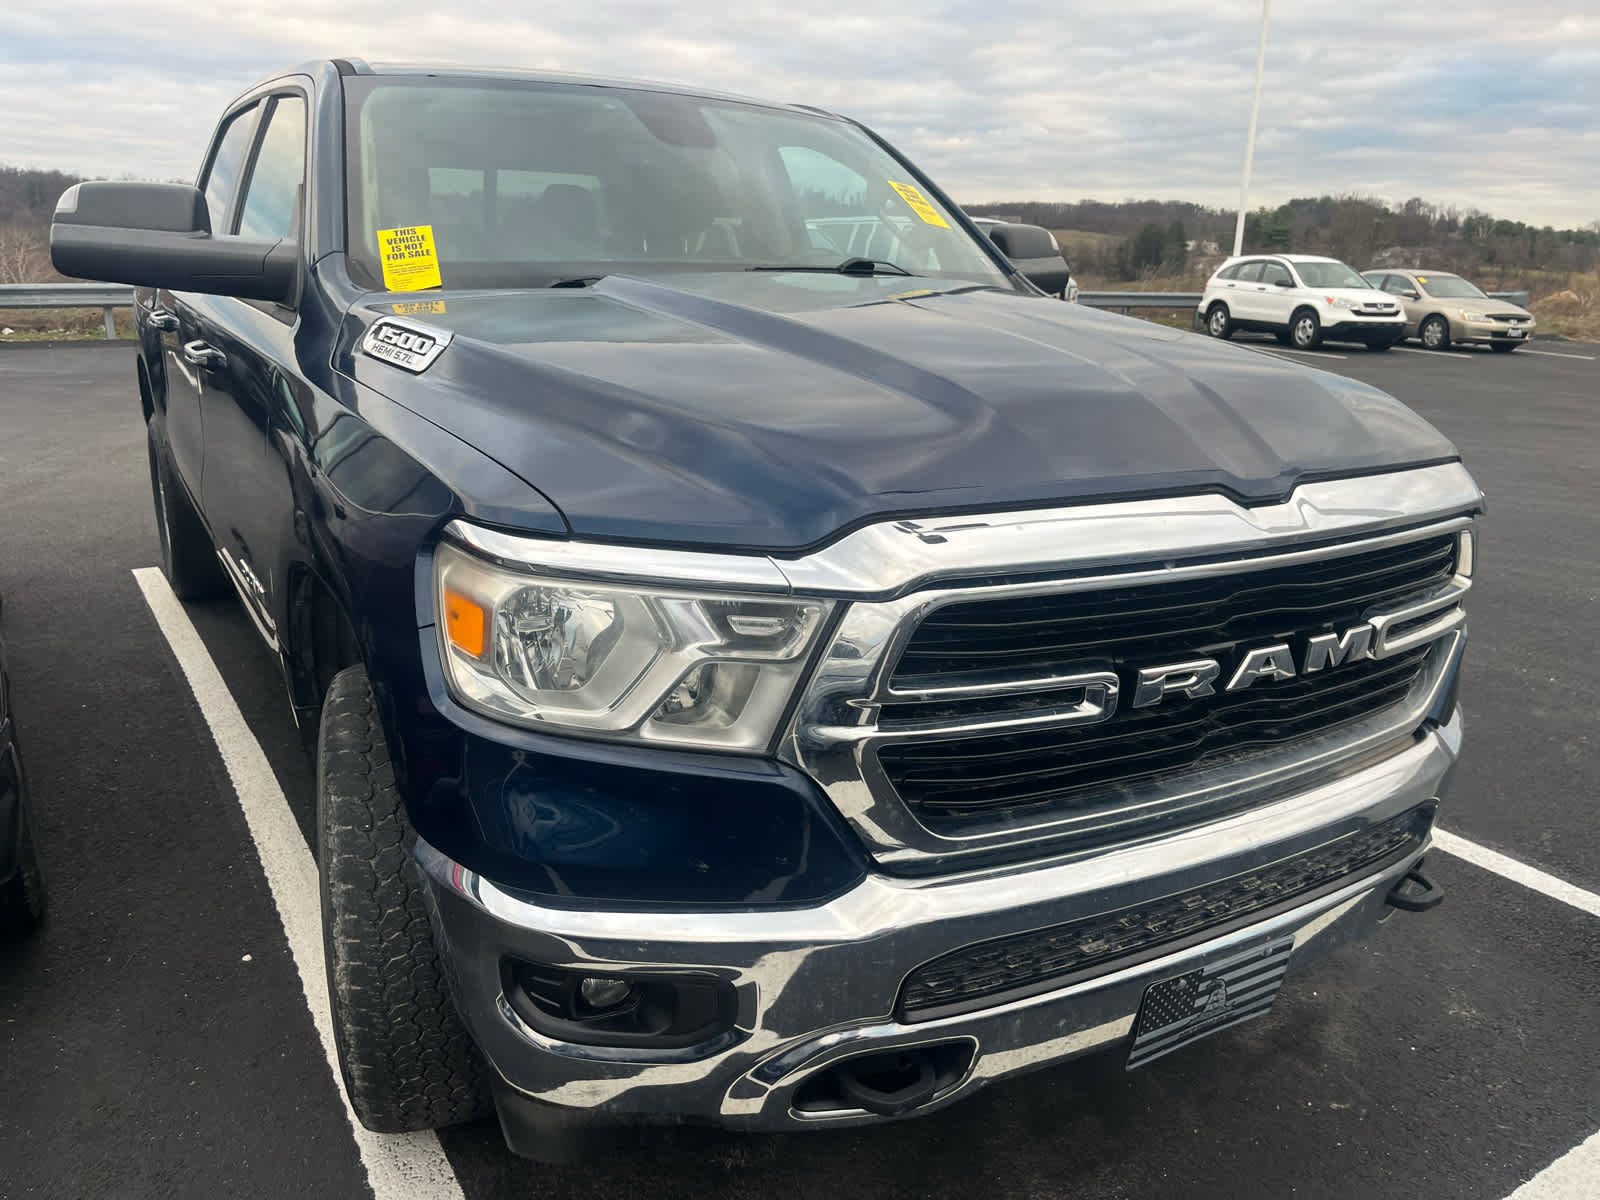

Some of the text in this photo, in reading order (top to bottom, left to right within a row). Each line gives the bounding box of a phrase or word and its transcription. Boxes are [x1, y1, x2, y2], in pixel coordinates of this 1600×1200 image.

[393, 228, 417, 237] THIS
[386, 234, 427, 246] VEHICLE
[391, 242, 423, 253] IS NOT
[386, 248, 432, 261] FOR SALE
[377, 325, 436, 356] 1500
[371, 343, 414, 364] HEMI 5.7L
[1132, 624, 1373, 709] RAM
